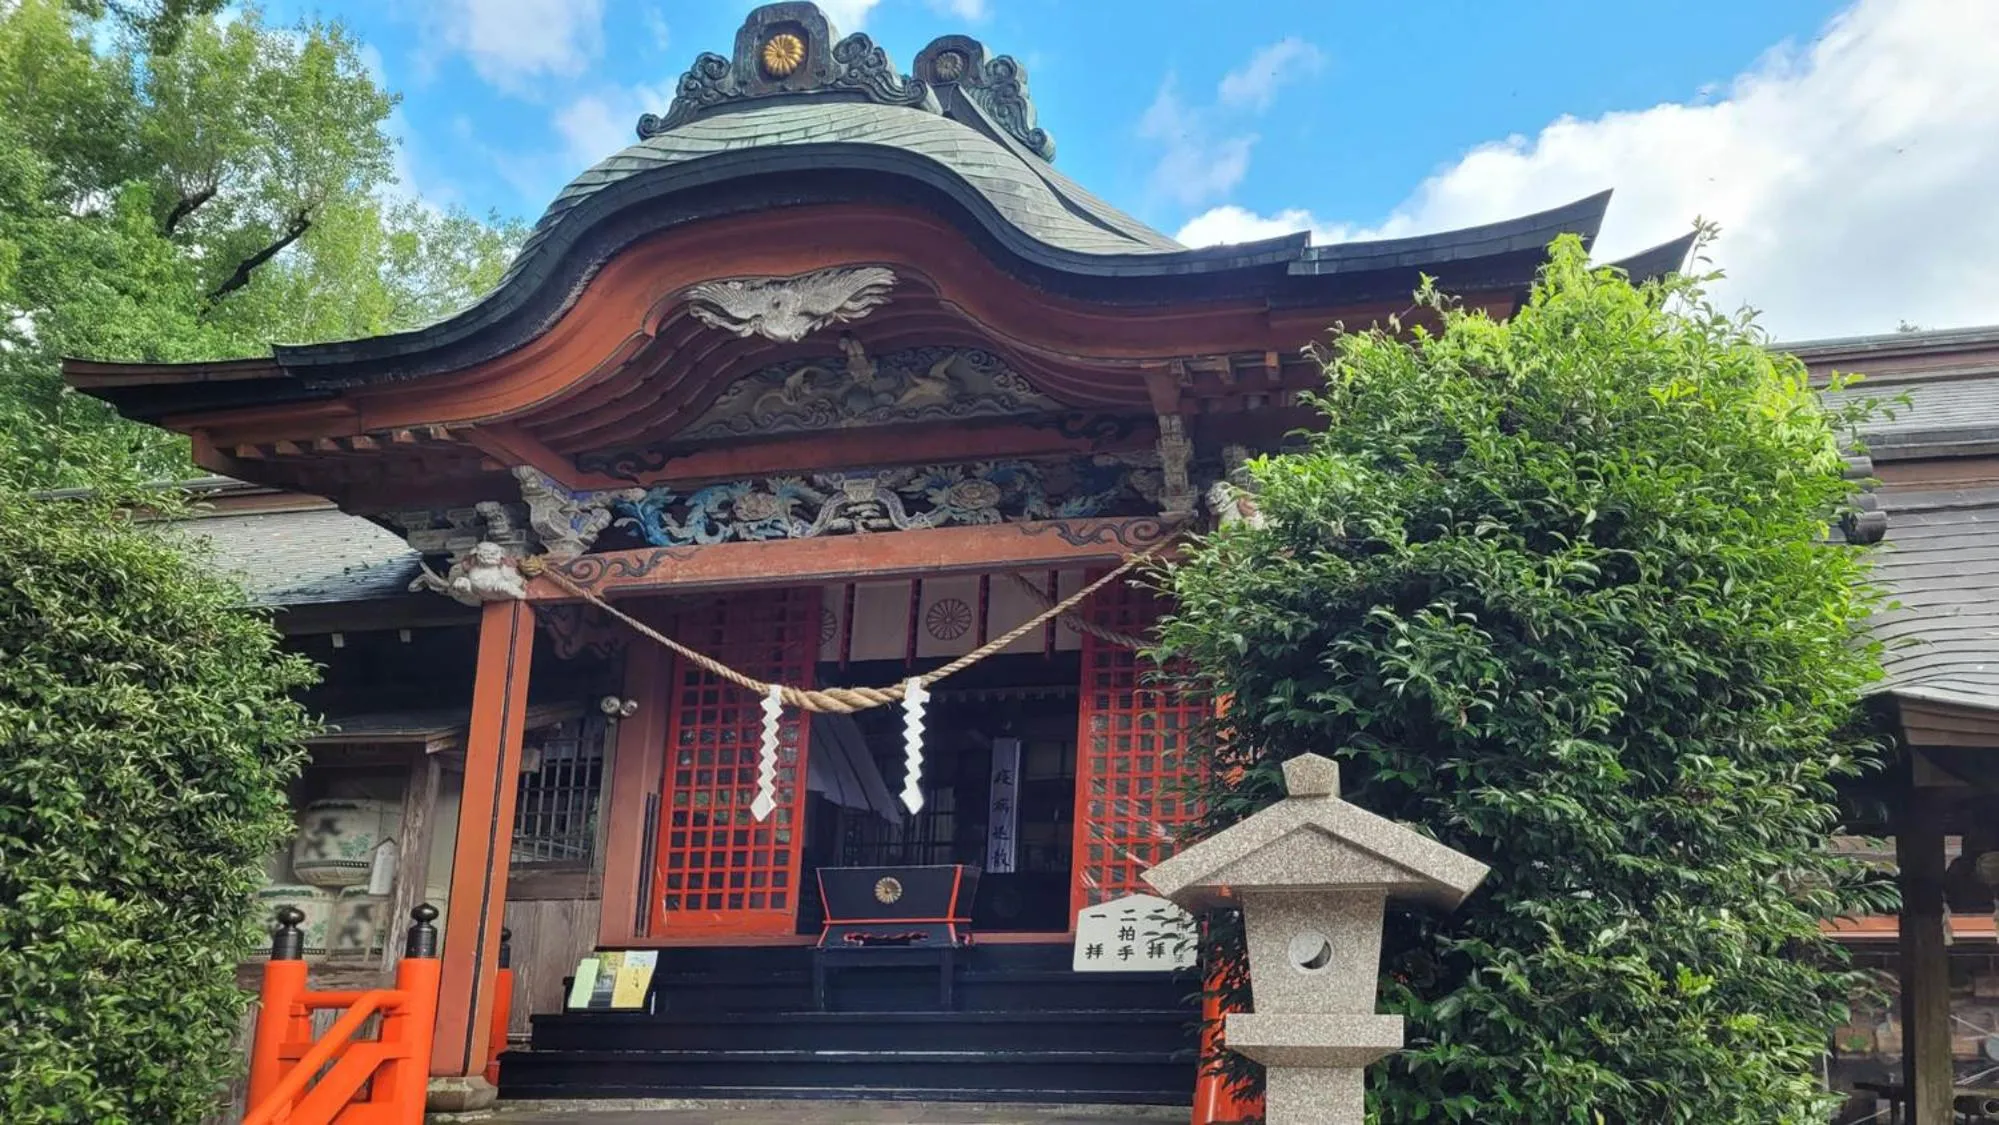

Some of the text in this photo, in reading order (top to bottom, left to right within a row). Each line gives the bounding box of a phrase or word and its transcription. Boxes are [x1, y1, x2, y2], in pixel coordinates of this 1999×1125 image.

[1085, 913, 1107, 960] 一拝
[1117, 908, 1137, 961] 二拍手
